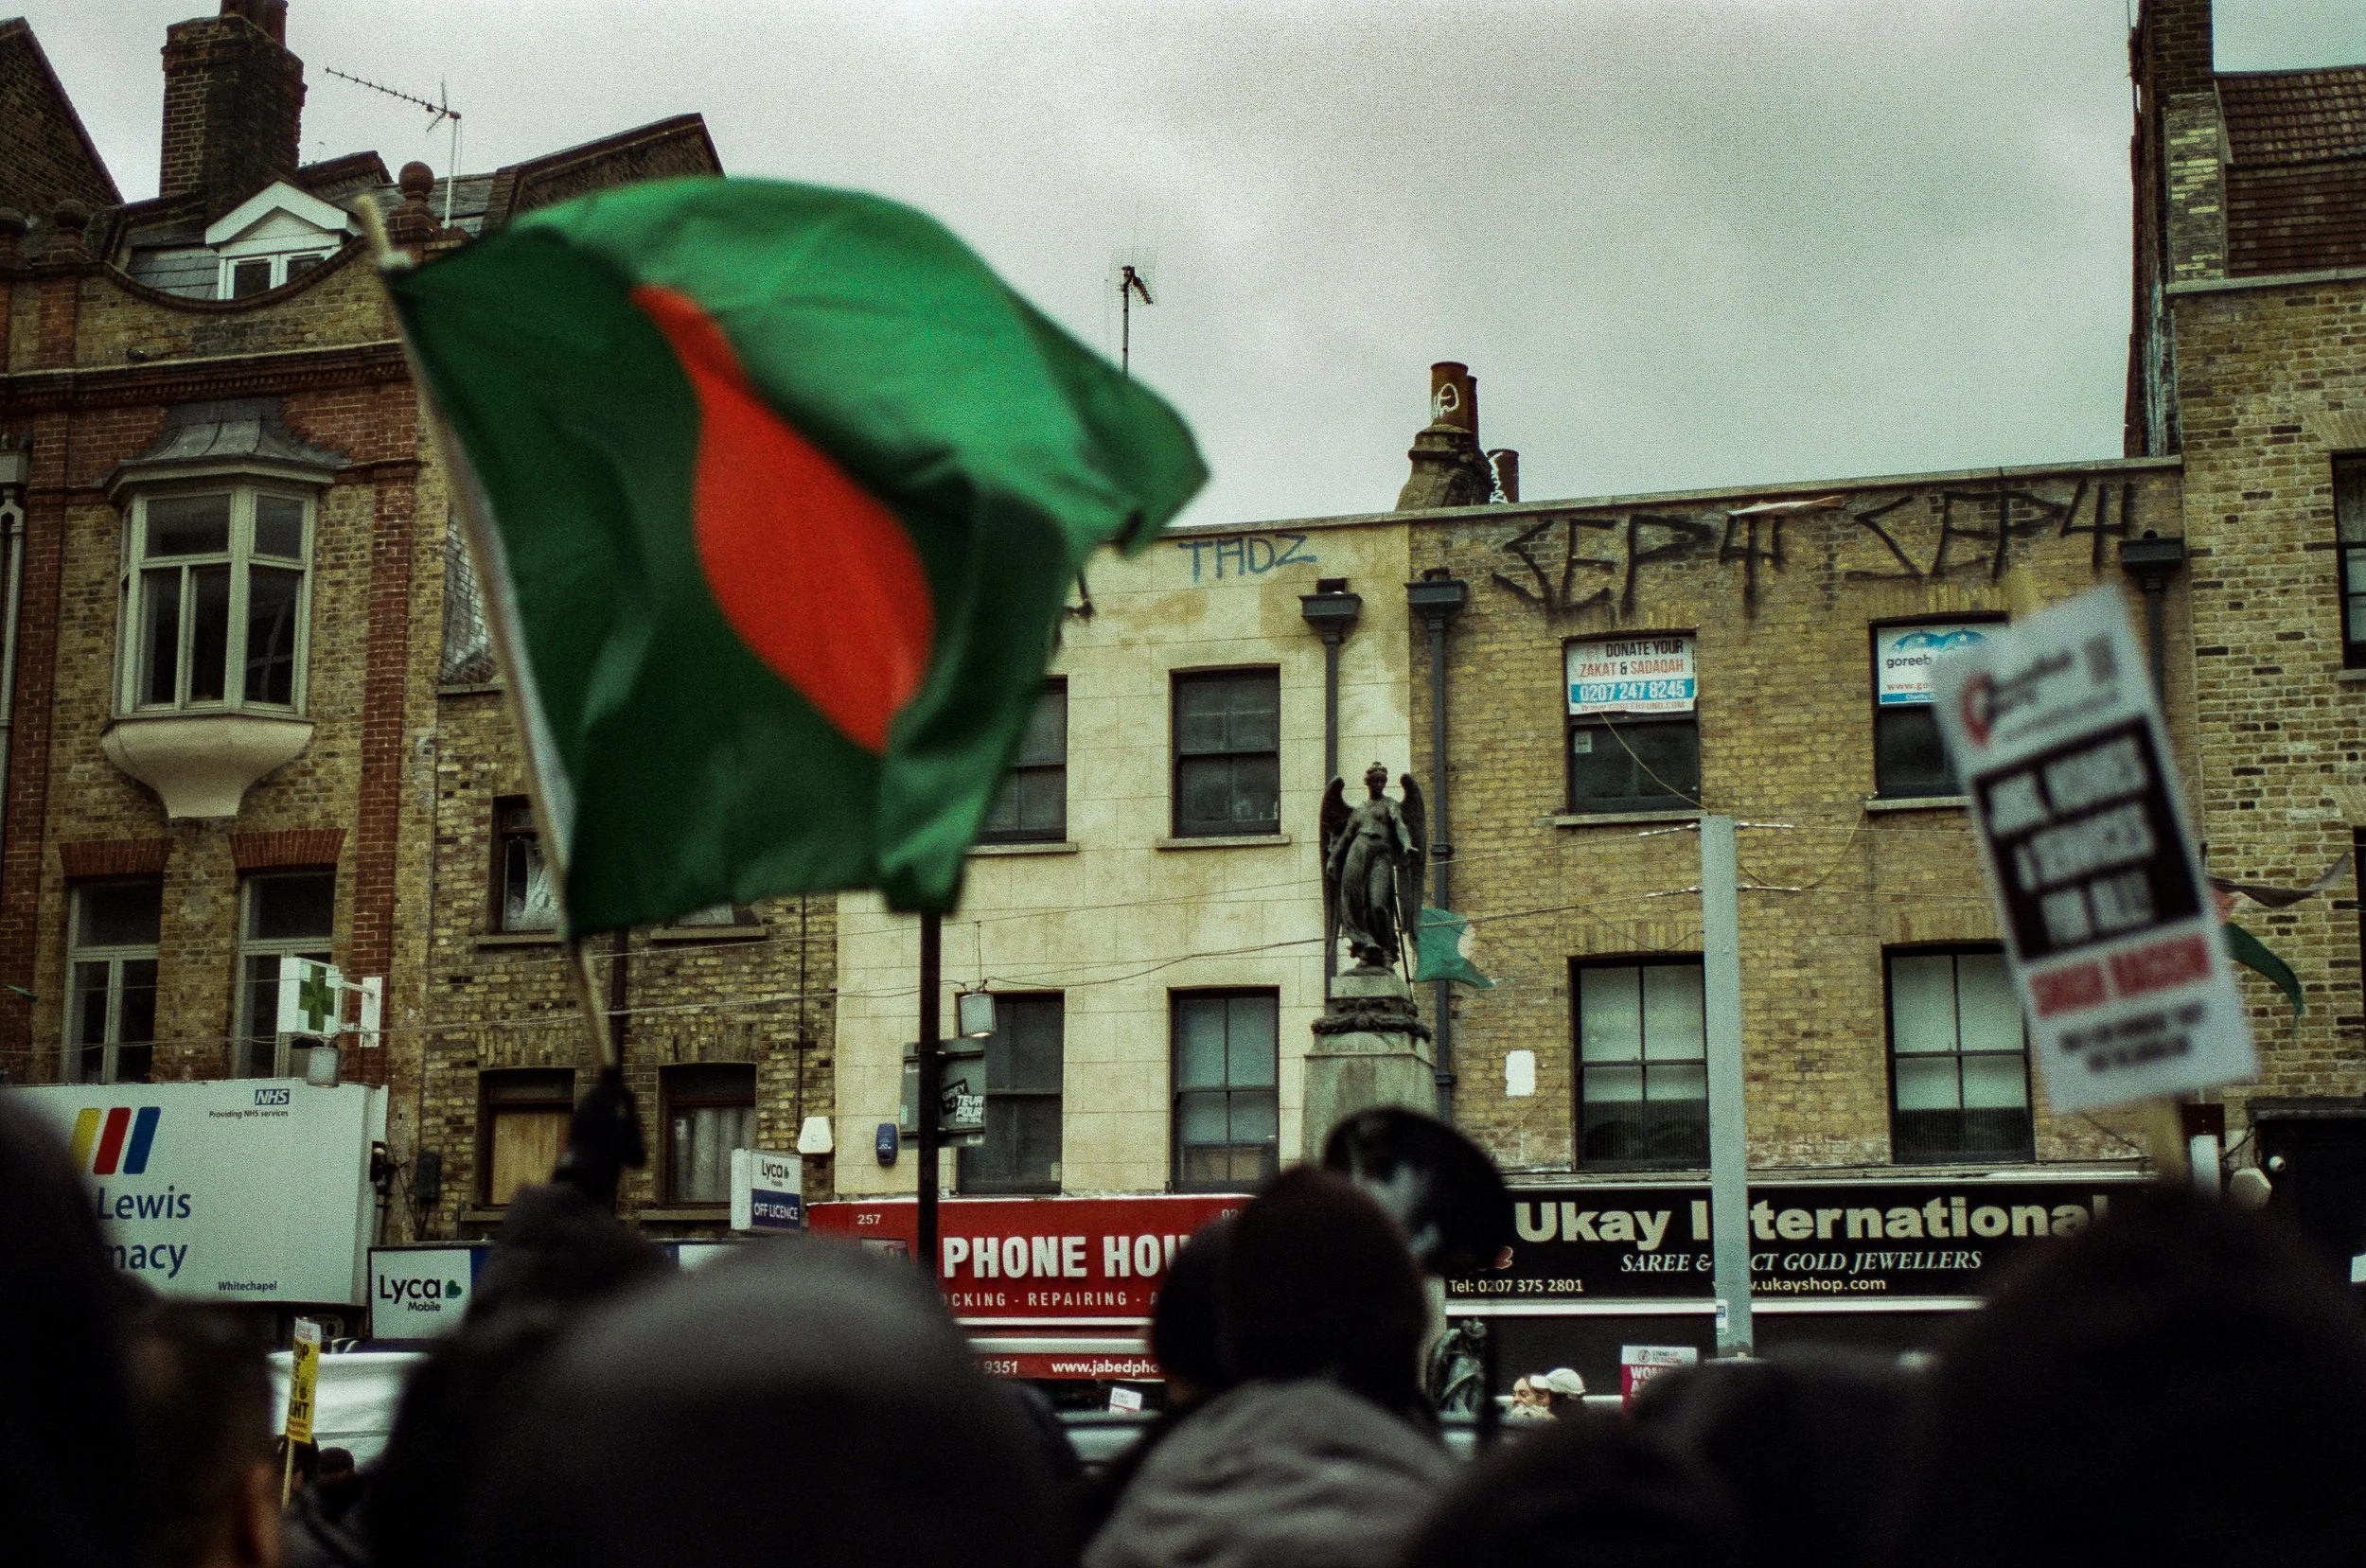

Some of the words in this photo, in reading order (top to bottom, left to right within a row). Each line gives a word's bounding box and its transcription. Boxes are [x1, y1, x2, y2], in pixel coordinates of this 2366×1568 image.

[1605, 643, 1650, 658] DONATE
[1653, 639, 1684, 654] YOUR
[1580, 662, 1616, 678] ZAKAT
[1619, 661, 1628, 676] &
[1580, 683, 1616, 701] 0207
[1619, 681, 1646, 699] 247
[1649, 679, 1685, 698] 8245
[256, 1090, 289, 1104] NHS
[209, 1110, 242, 1119] Providing
[244, 1109, 259, 1118] NHS
[761, 1159, 784, 1181] Lyca
[97, 1185, 191, 1220] Lewis
[753, 1203, 768, 1218] OFF
[768, 1204, 799, 1221] LICENCE
[857, 1214, 882, 1225] 257
[1515, 1201, 1671, 1251] Ukay
[943, 1235, 1087, 1278] PHONE
[1621, 1254, 1689, 1273] SAREE
[1695, 1254, 1712, 1272] &
[1783, 1252, 1847, 1272] GOLD
[1848, 1251, 1983, 1275] JEWELLERS
[218, 1280, 278, 1296] Whitechapel
[380, 1275, 441, 1304] Lyca
[1450, 1280, 1474, 1293] Tel:
[1478, 1279, 1513, 1294] 0207
[1517, 1280, 1544, 1294] 375
[1547, 1279, 1584, 1294] 2801
[407, 1300, 442, 1312] Mobile
[1027, 1292, 1128, 1306] REPAIRING
[1051, 1358, 1159, 1377] www.jabedpho
